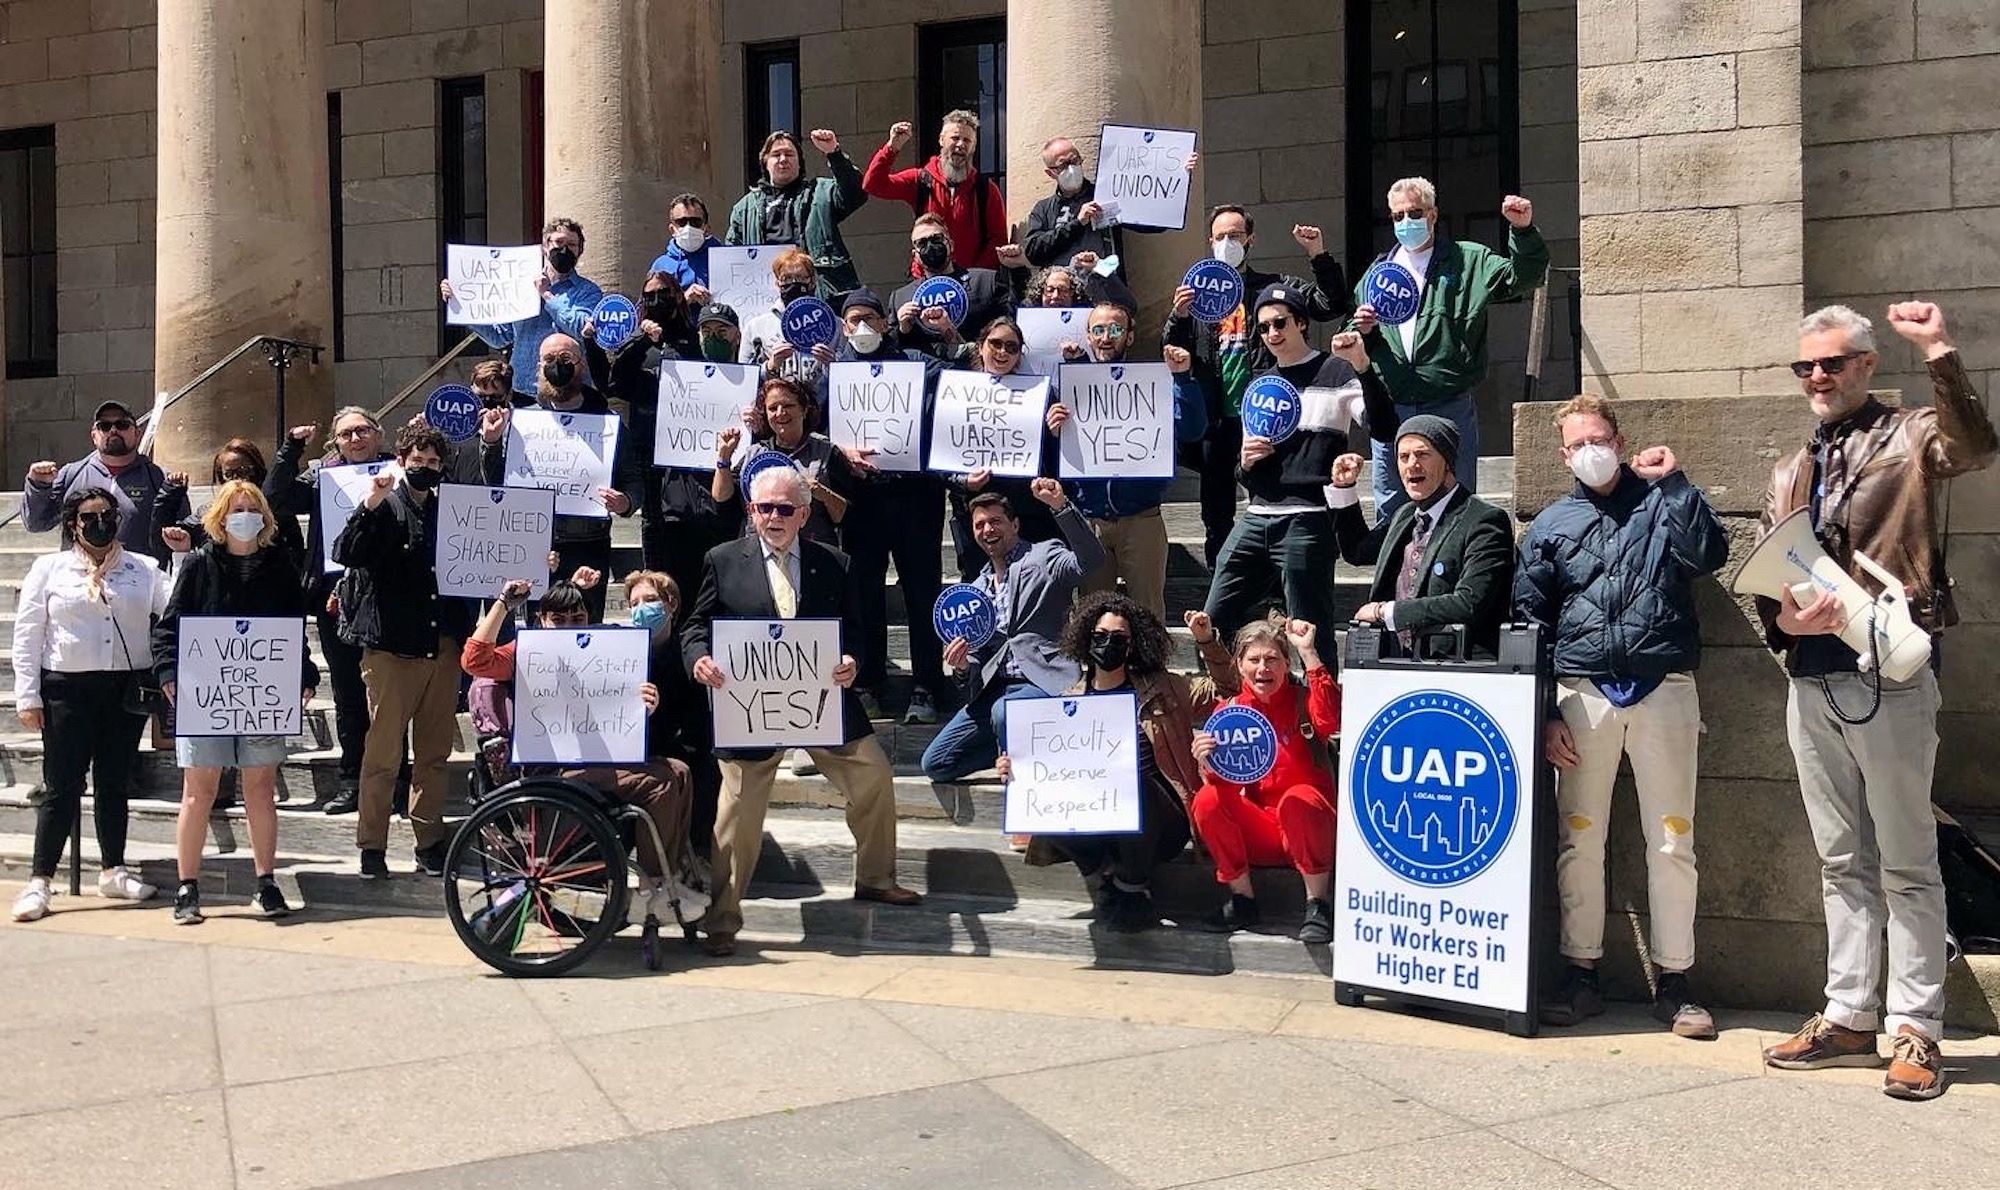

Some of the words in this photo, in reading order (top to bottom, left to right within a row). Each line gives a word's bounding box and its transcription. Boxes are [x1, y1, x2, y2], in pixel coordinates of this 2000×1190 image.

[1116, 145, 1181, 171] UARTS
[1112, 174, 1181, 198] UNION!
[1194, 275, 1234, 292] UAP
[1376, 273, 1411, 299] UAP
[922, 290, 957, 306] UAP
[599, 310, 629, 323] UAP
[790, 308, 823, 330] UAP
[668, 379, 704, 400] WE
[837, 381, 911, 414] UNION
[942, 385, 957, 400] A
[963, 385, 1026, 405] VOICE
[1073, 381, 1155, 423] UNION
[436, 399, 475, 415] UAP
[670, 402, 720, 420] WANT
[728, 402, 741, 422] A
[1251, 392, 1291, 413] UAP
[966, 406, 1008, 425] FOR
[846, 418, 914, 456] YES!
[950, 424, 1027, 449] UARTS
[1082, 425, 1161, 465] YES!
[961, 449, 1032, 468] STAFF!
[451, 504, 490, 530] WE
[499, 508, 549, 534] NEED
[446, 534, 527, 565] SHARED
[942, 599, 981, 622] UAP
[187, 638, 203, 658] A
[214, 637, 289, 661] VOICE
[727, 640, 819, 682] UNION
[220, 665, 259, 683] FOR
[195, 684, 281, 708] UARTS
[532, 679, 560, 699] and
[209, 706, 294, 731] STAFF!
[531, 703, 638, 737] Solidarity
[728, 688, 830, 734] YES!
[1031, 719, 1122, 758] Faculty
[1213, 726, 1262, 746] UAP
[1358, 708, 1398, 762] UNITED
[1408, 698, 1497, 741] ACADEMICS
[1033, 760, 1108, 784] Deserve
[1381, 745, 1488, 788] UAP
[1026, 788, 1118, 820] Respect!
[1412, 790, 1437, 801] LOCAL
[1374, 840, 1489, 881] PHILADELPHIA
[1347, 887, 1432, 926] Building
[1439, 899, 1510, 931] Power
[1354, 917, 1383, 944] for
[1390, 922, 1479, 959] Workers
[1485, 935, 1506, 963] in
[1376, 951, 1447, 985] Higher
[1453, 963, 1480, 991] Ed
